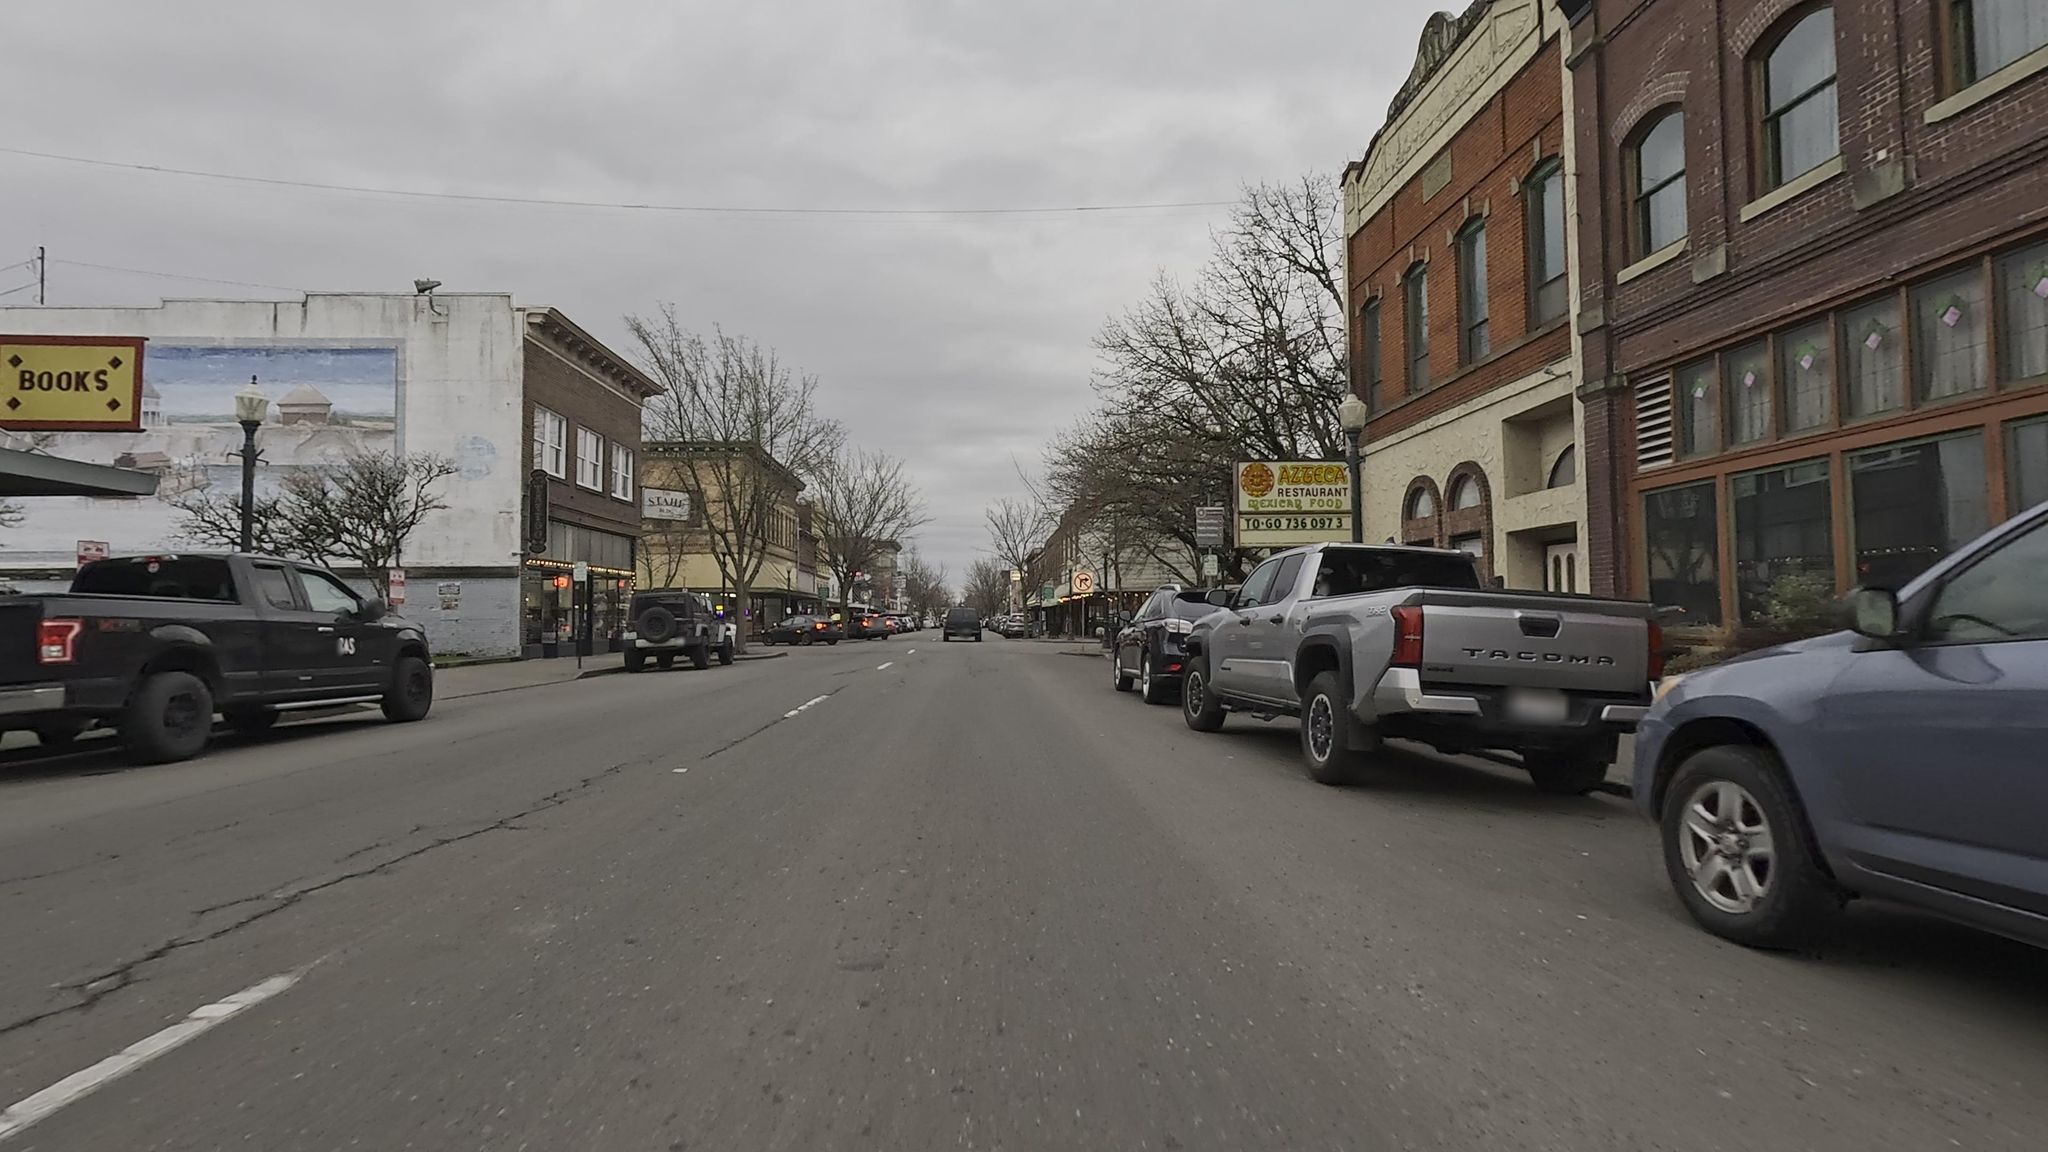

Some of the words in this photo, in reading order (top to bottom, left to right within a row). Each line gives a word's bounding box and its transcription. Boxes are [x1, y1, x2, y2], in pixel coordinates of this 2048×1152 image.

[19, 369, 108, 392] BOOKS
[1278, 465, 1348, 485] AZTECA
[1277, 487, 1348, 497] RESTAURANT
[1248, 499, 1303, 510] MEXICAN
[1310, 499, 1343, 509] FOOD
[1285, 518, 1307, 529] 736
[1461, 648, 1617, 667] TACOMA
